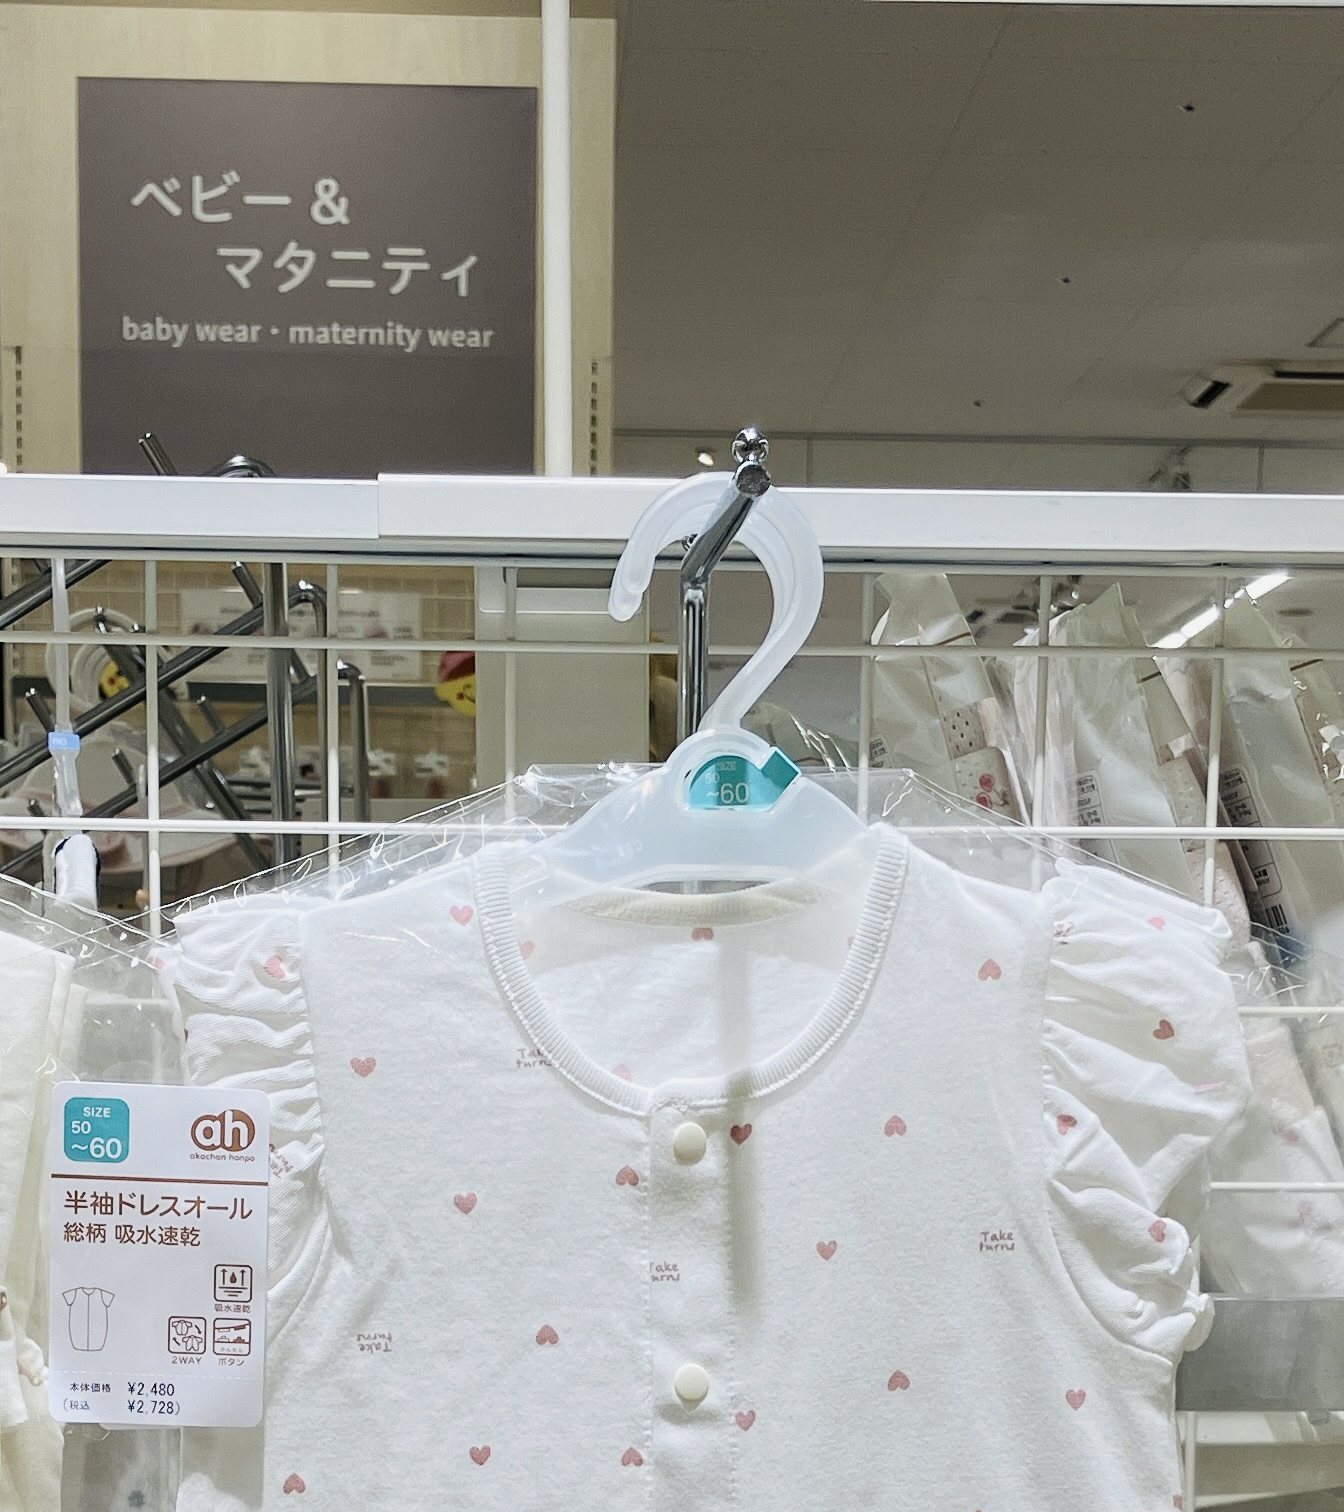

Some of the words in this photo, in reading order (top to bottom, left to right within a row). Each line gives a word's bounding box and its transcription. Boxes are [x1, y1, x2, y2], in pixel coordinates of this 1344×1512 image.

[130, 169, 292, 224] ベビー
[309, 177, 351, 226] &
[216, 241, 479, 298] マタニティ
[121, 315, 190, 348] baby
[196, 322, 261, 345] wear
[288, 321, 422, 353] maternity
[427, 327, 495, 349] wear
[83, 1106, 112, 1119] SIZE
[70, 1120, 93, 1136] 50
[190, 1108, 257, 1153] ah
[63, 1190, 254, 1221] 半袖ドレスオール
[63, 1222, 108, 1244] 総柄
[114, 1224, 202, 1248] 吸水速乾
[980, 1230, 1014, 1243] Take
[171, 1356, 203, 1366] 2WAY
[358, 1342, 393, 1355] Take
